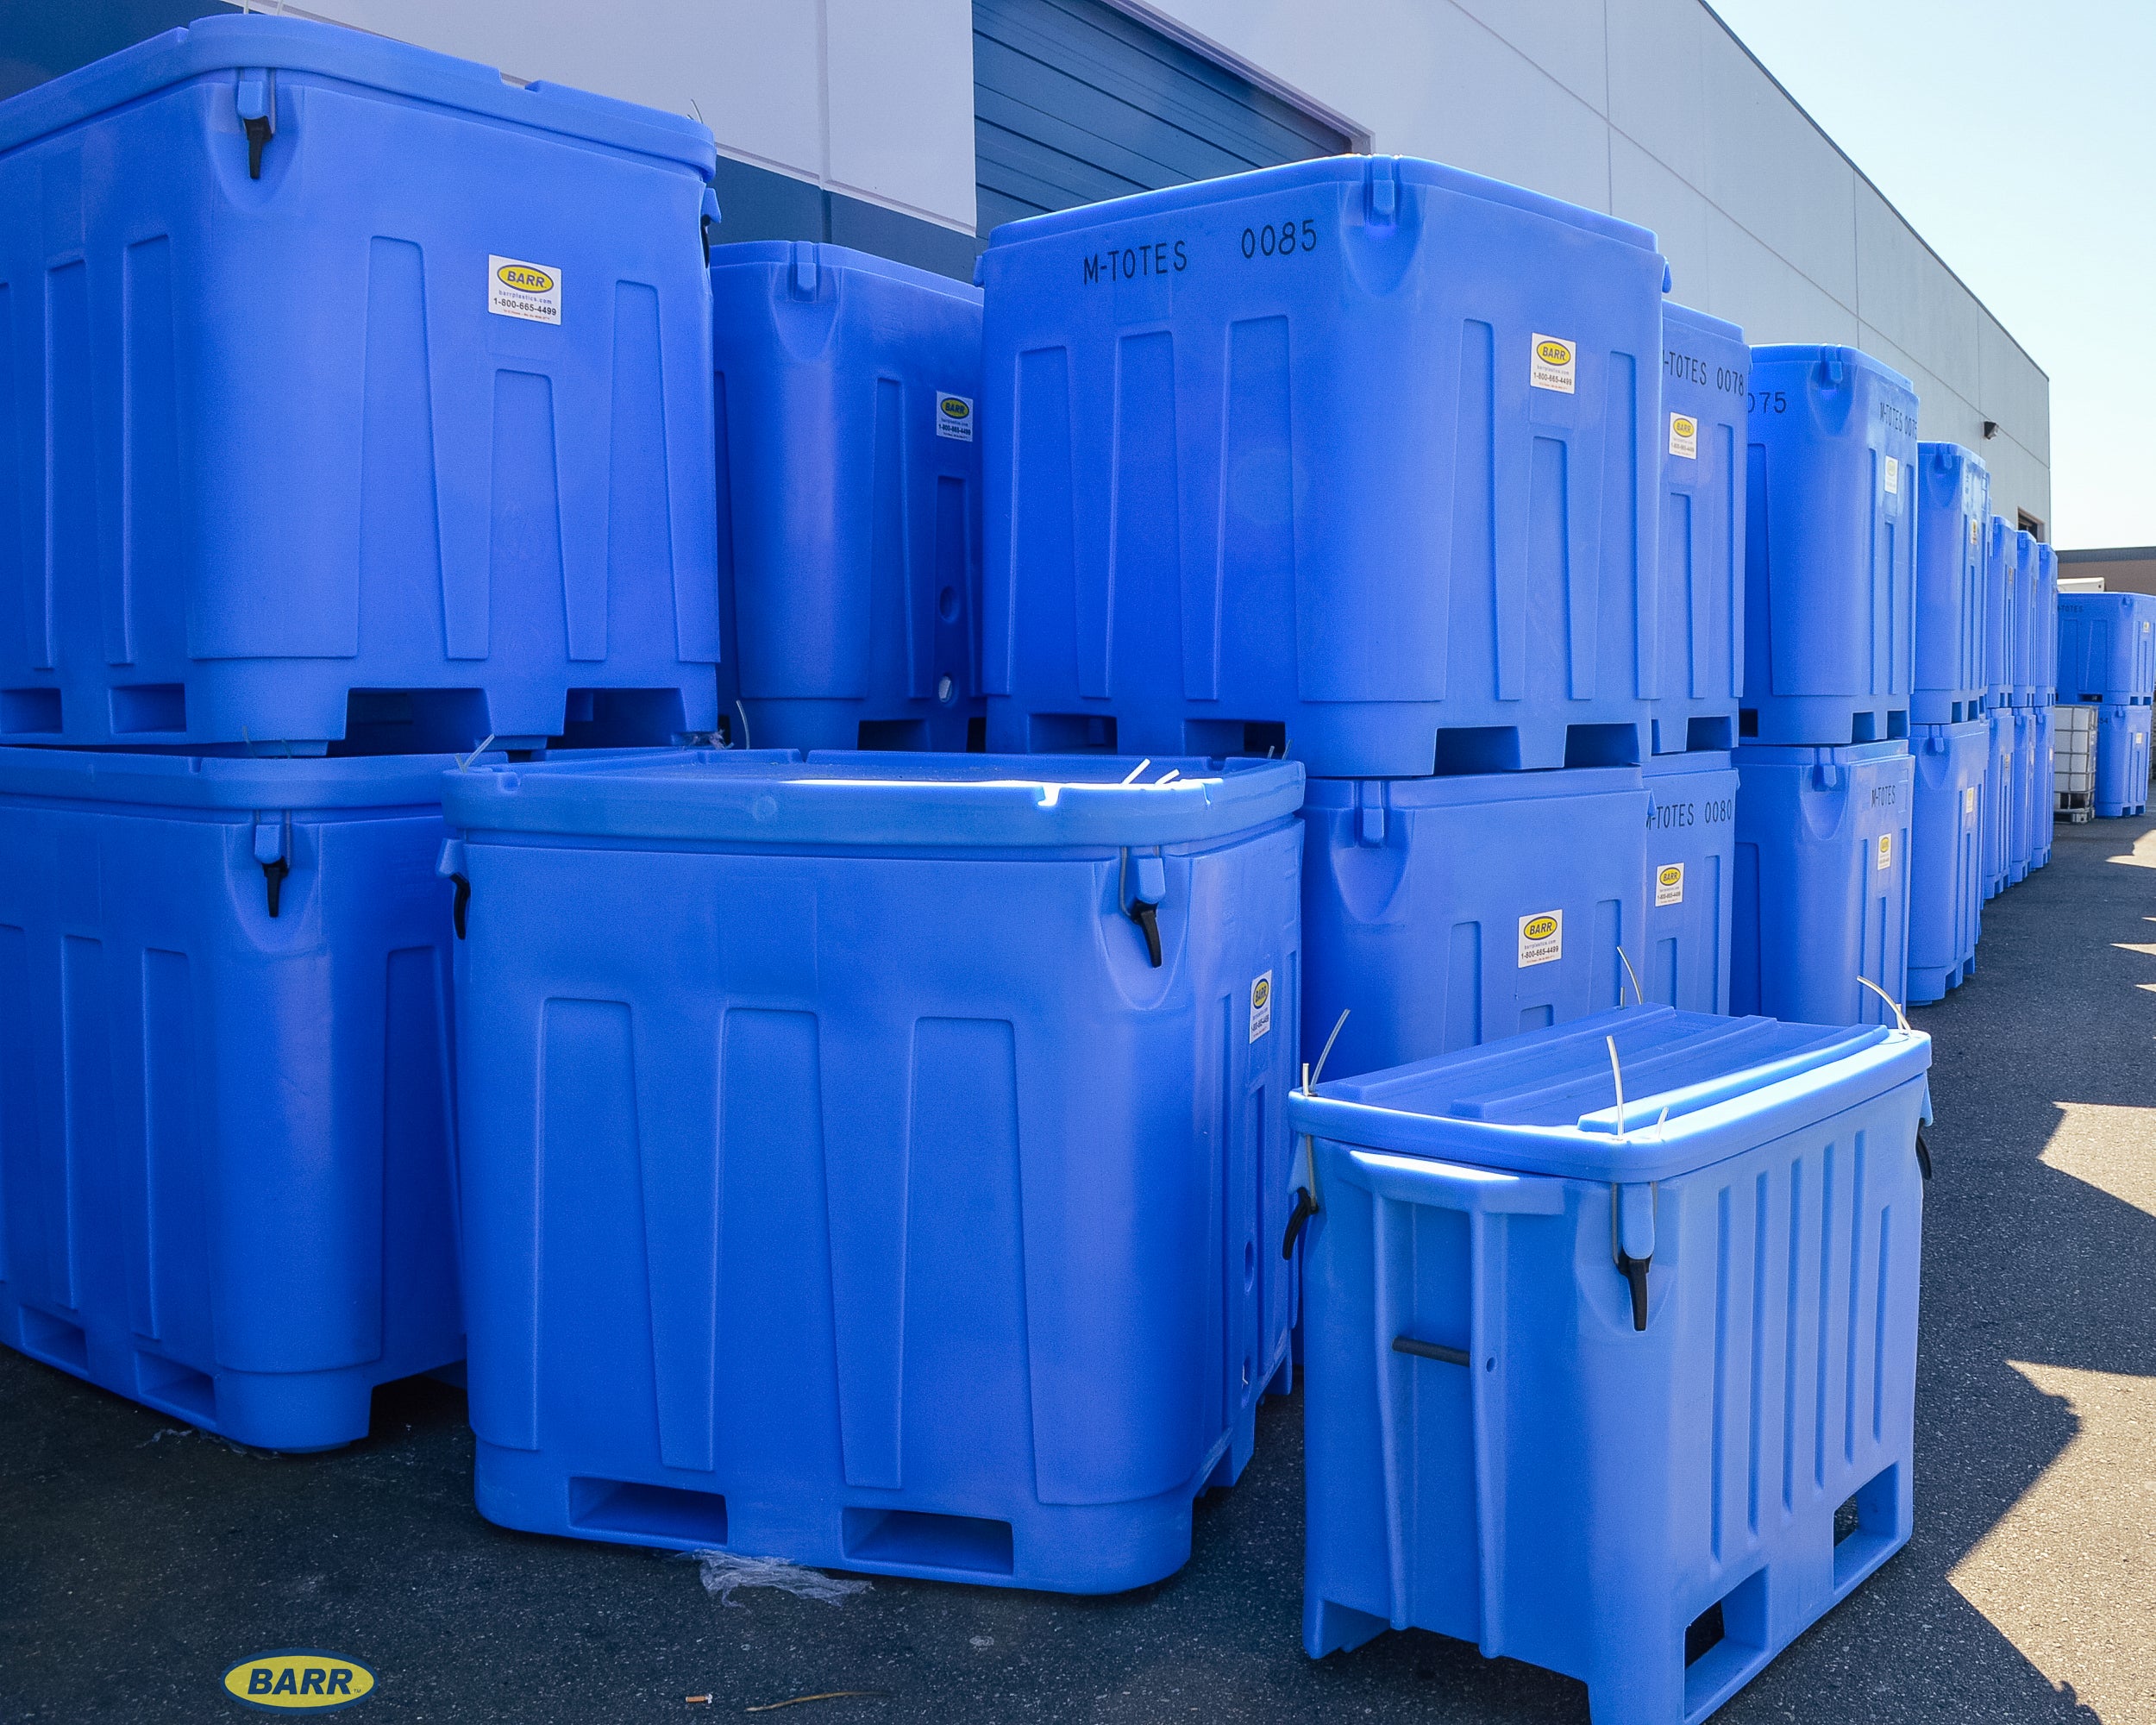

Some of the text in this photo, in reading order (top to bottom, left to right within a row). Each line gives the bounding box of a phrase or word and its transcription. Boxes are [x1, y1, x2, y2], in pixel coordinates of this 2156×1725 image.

[1084, 219, 1317, 285] M-TOTES 0085
[507, 271, 545, 288] BARR
[498, 290, 553, 304] barrplastics.com
[493, 298, 557, 316] 1-800-665-4499
[1542, 347, 1566, 361] BARR
[1662, 349, 1744, 397] -TOTES 0078
[945, 402, 965, 414] BARR
[1880, 402, 1903, 432] M-TOTES
[1871, 785, 1896, 808] M-TOTES
[1705, 799, 1733, 824] 0080
[1663, 872, 1678, 881] BARR
[1529, 921, 1552, 936] BARR
[1520, 945, 1559, 960] 1-800-665-4499
[1256, 986, 1267, 1003] BARR
